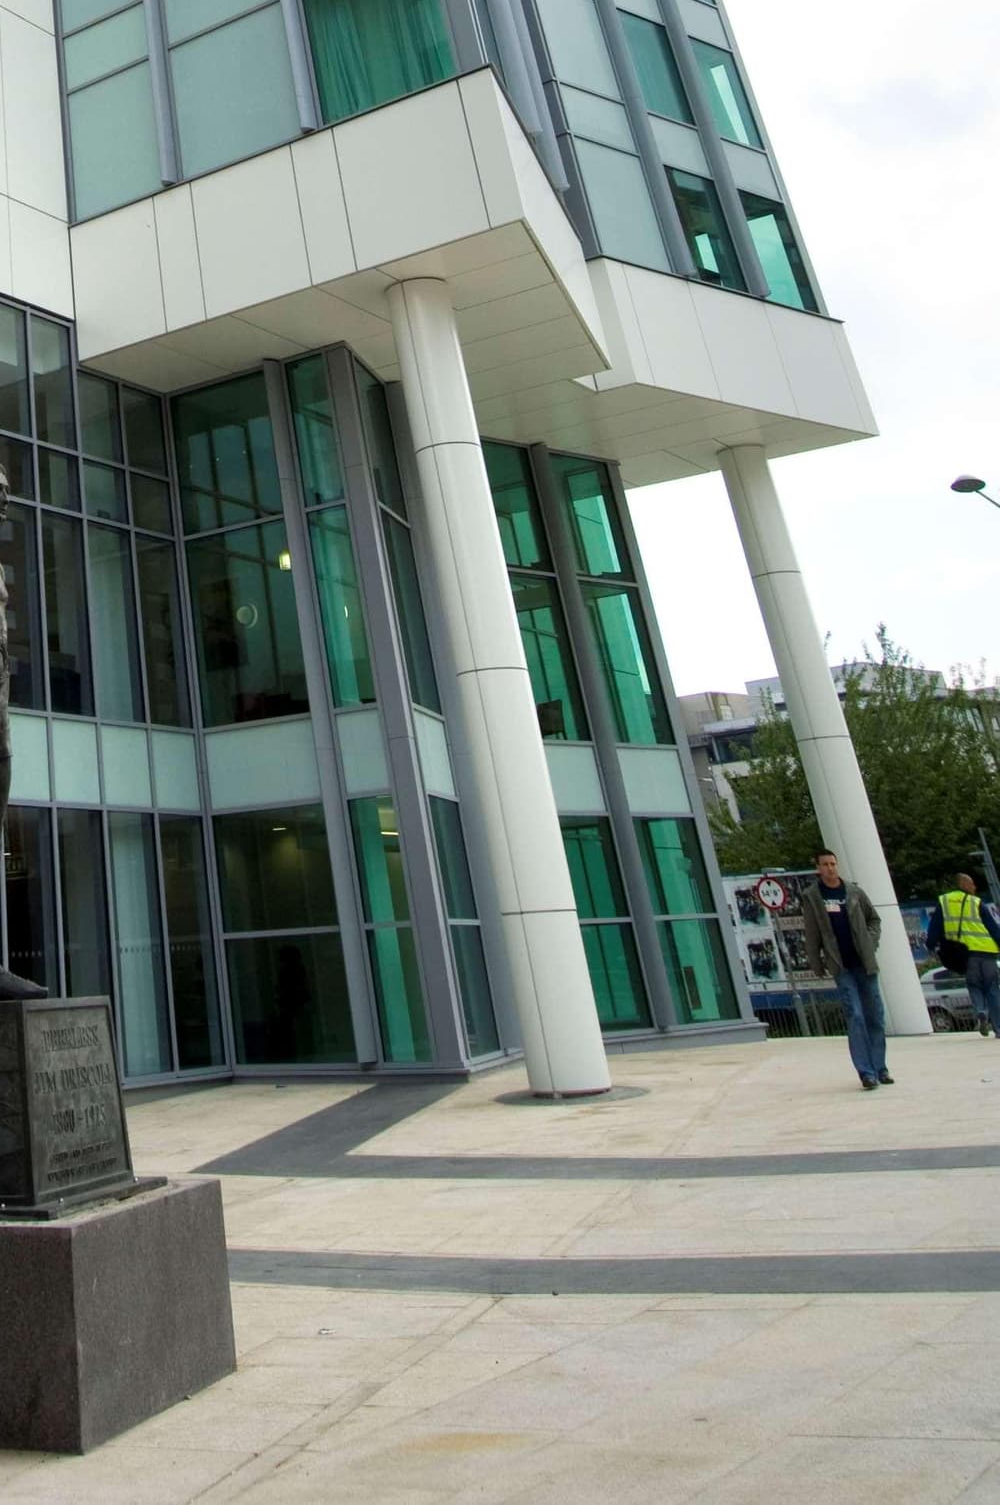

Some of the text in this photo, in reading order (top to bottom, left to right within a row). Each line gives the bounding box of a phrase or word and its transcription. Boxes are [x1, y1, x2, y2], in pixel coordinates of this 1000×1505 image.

[42, 1025, 99, 1051] PEERLESS
[34, 1063, 112, 1094] JIM DRISCOLL
